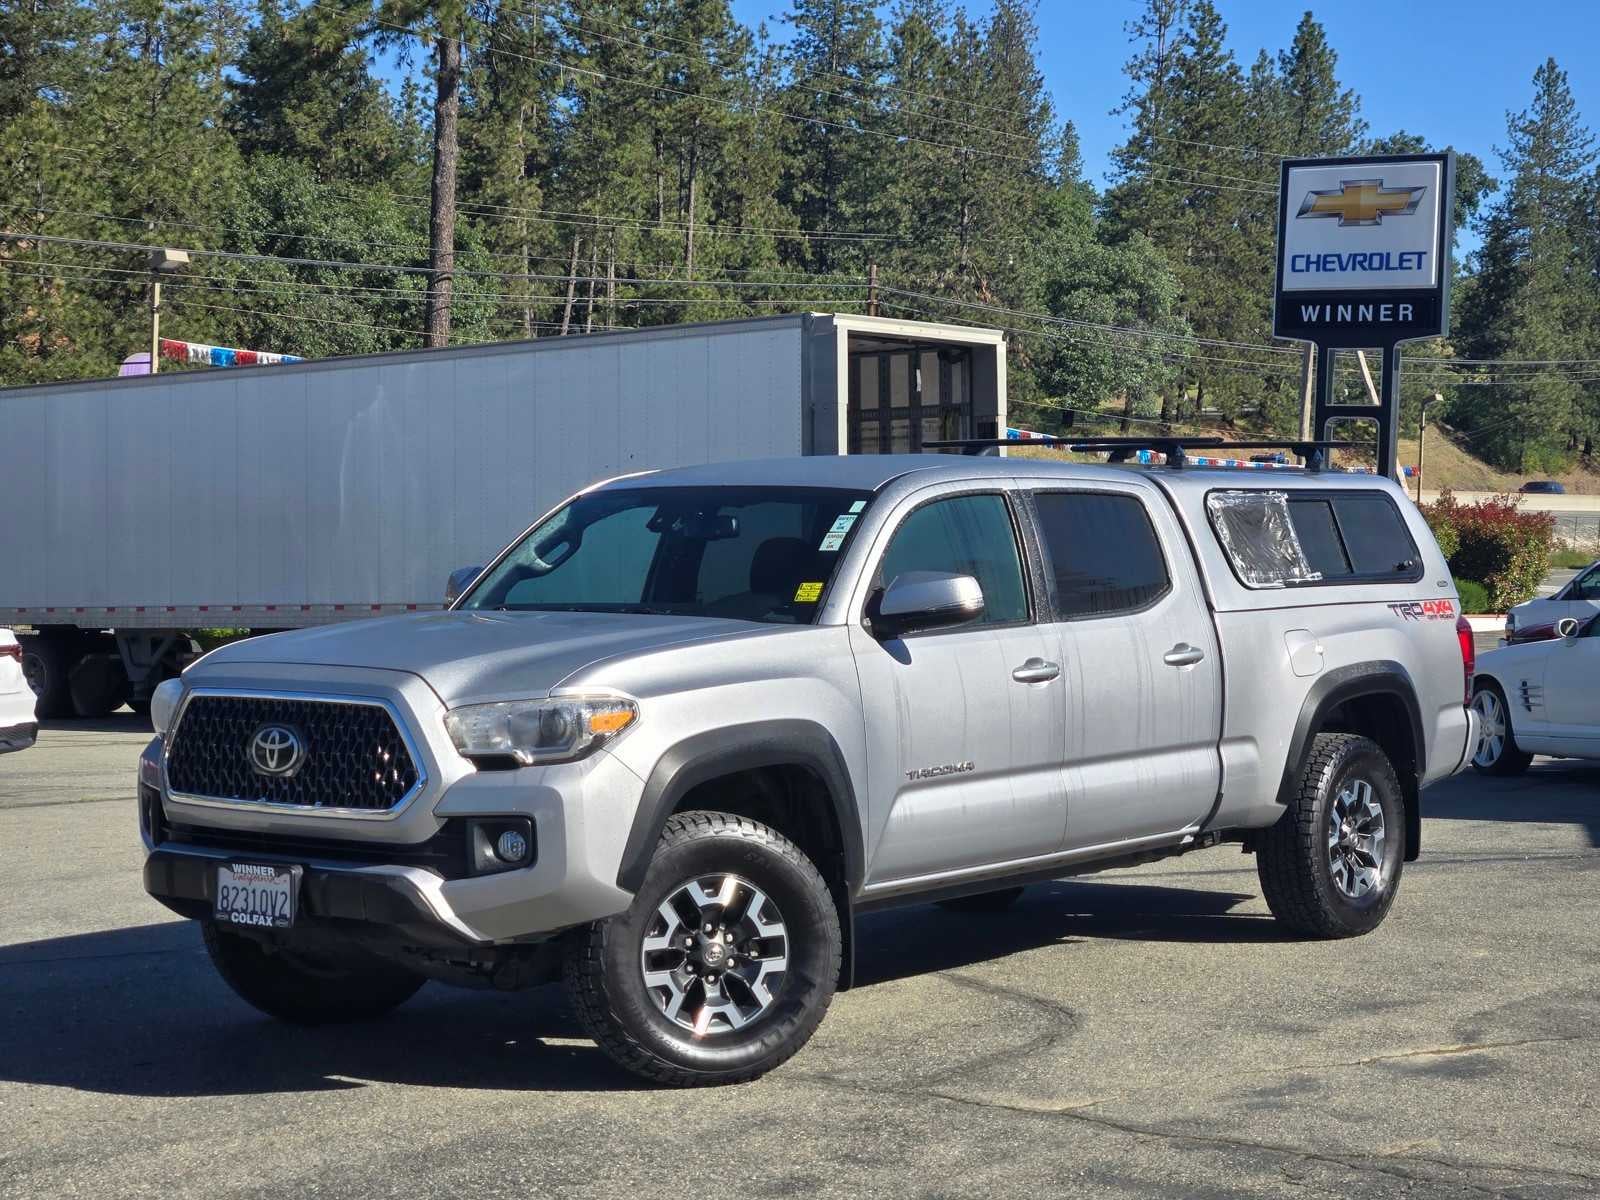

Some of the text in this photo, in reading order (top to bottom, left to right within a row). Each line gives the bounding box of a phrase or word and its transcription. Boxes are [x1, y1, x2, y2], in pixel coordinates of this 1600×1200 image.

[1291, 251, 1427, 273] CHEVROLET
[1301, 303, 1413, 322] WINNER
[905, 761, 975, 780] TACOMA
[232, 864, 275, 876] WINNER
[231, 912, 273, 926] COLFAX
